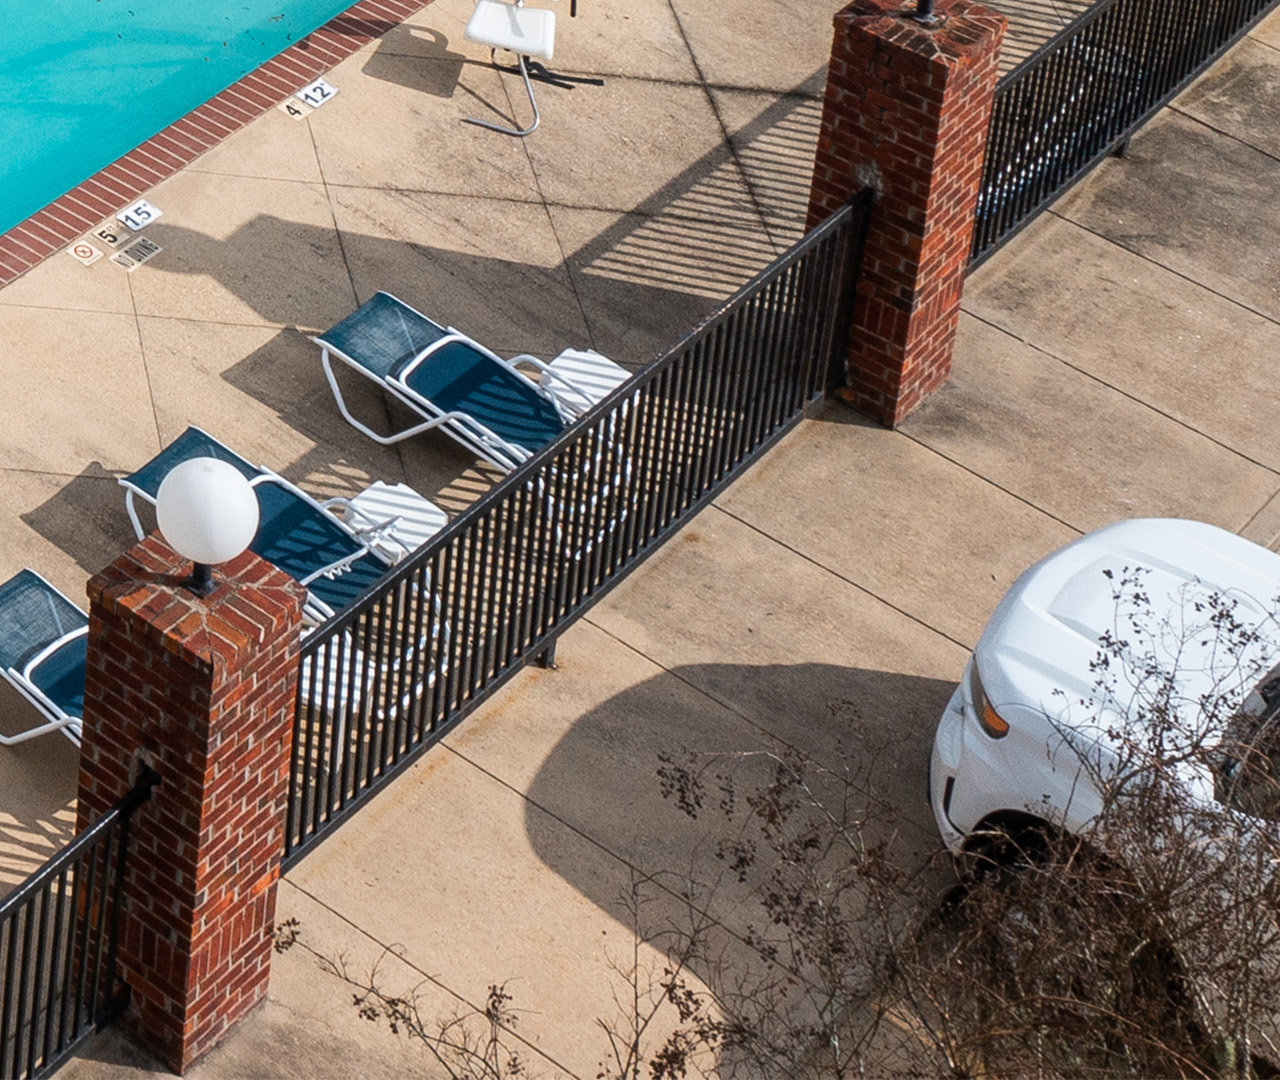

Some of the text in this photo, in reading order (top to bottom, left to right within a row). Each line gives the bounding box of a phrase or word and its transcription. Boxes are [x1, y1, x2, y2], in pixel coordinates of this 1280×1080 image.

[285, 104, 302, 117] 4
[98, 229, 118, 244] 5
[114, 255, 135, 269] NO
[126, 238, 159, 262] DIVING
